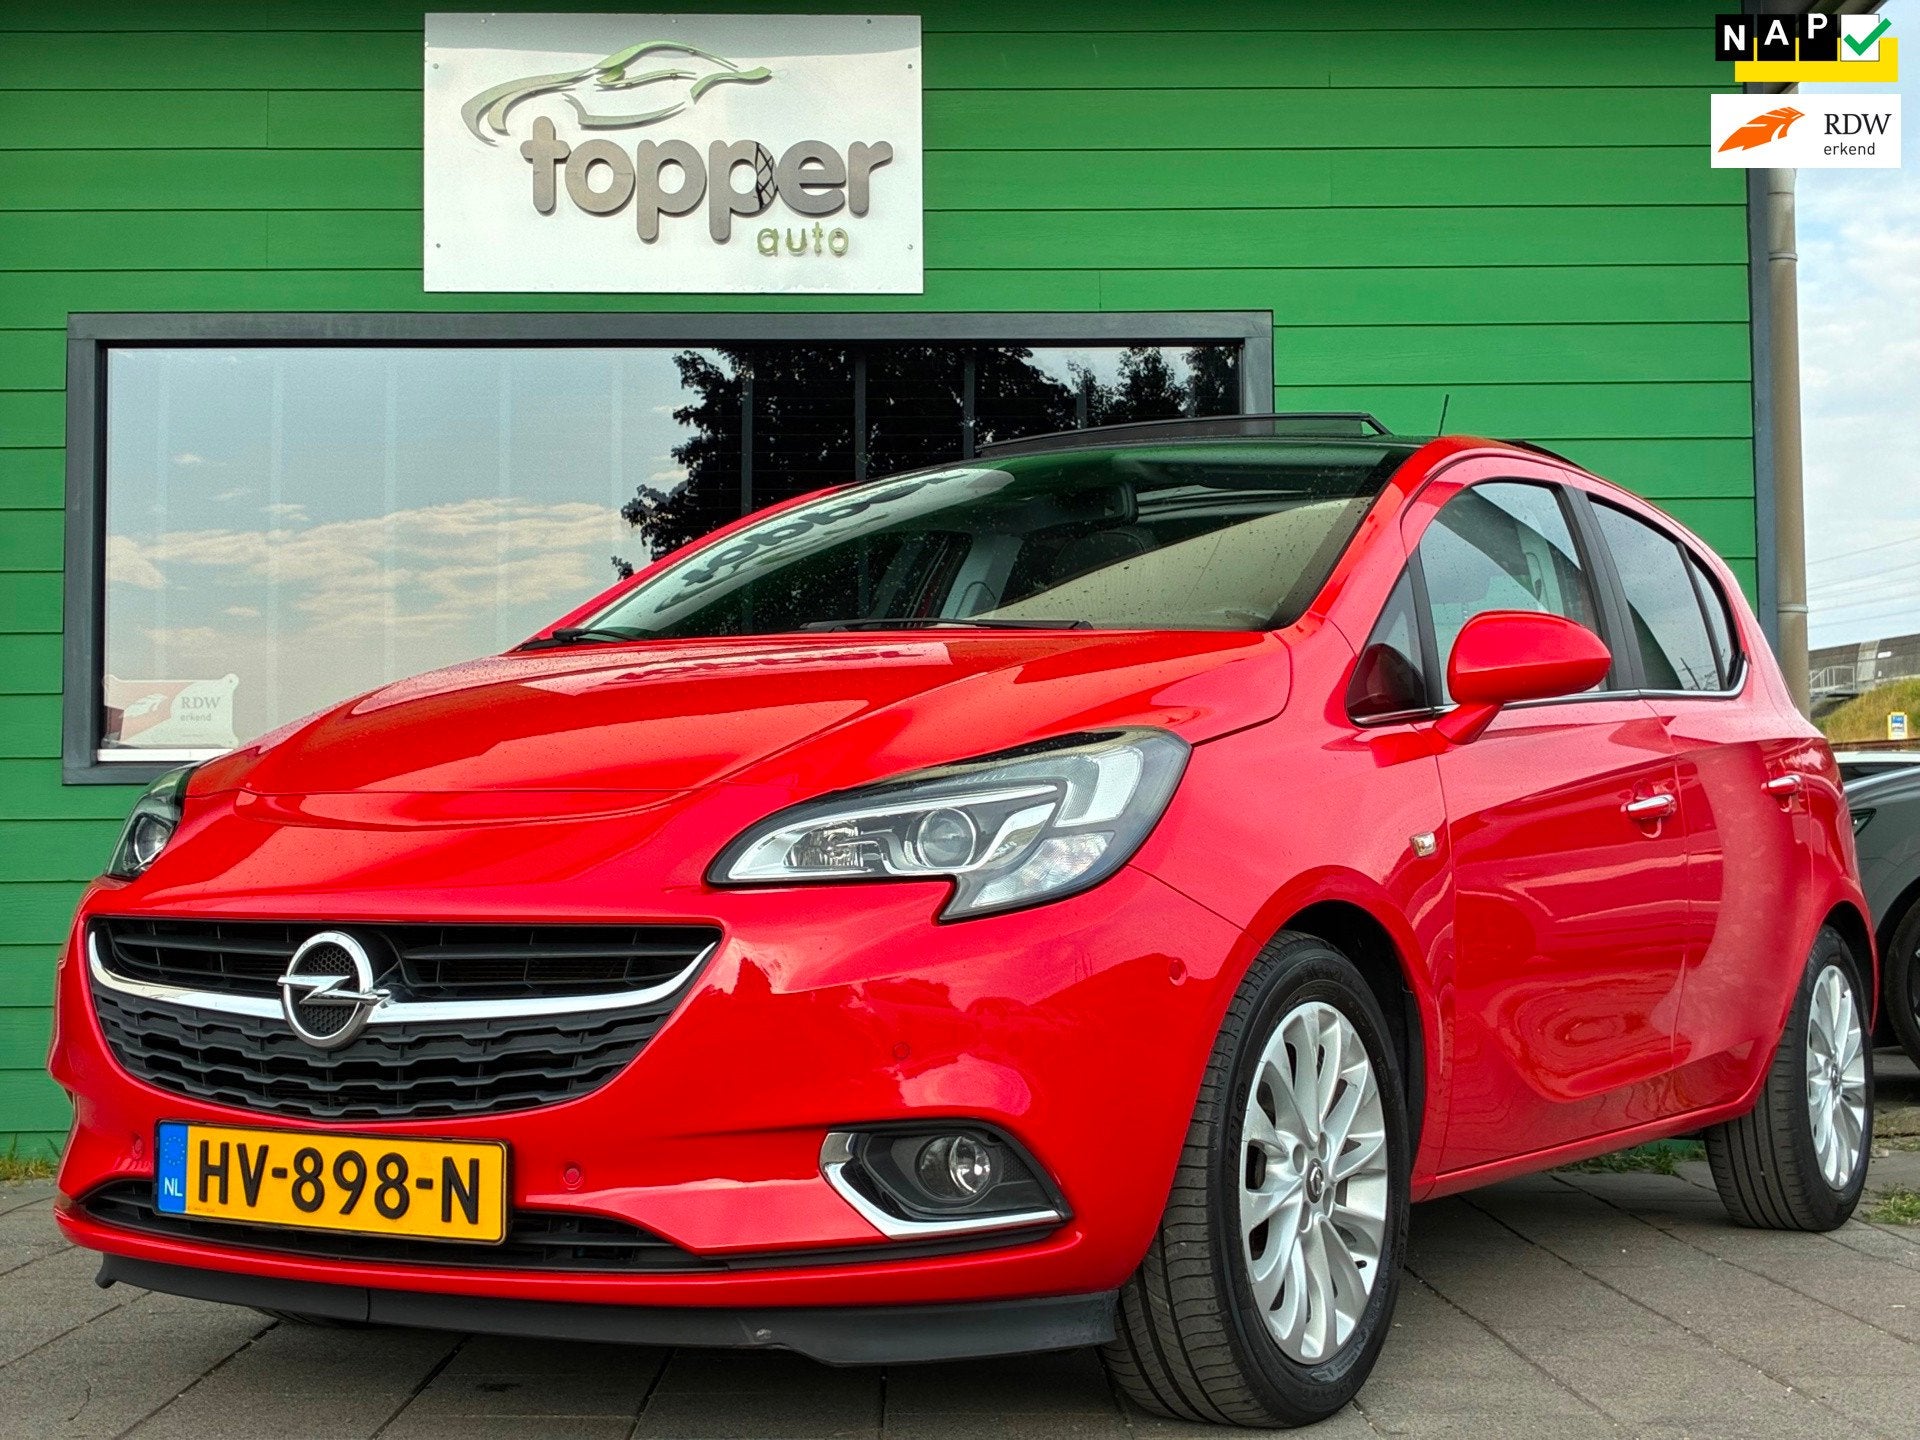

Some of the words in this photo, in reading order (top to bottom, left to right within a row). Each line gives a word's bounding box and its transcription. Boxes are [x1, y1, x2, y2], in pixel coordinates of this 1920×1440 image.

[520, 116, 894, 242] topper
[757, 221, 850, 256] auto
[180, 696, 221, 709] RDW
[180, 712, 212, 722] erkend
[163, 1177, 183, 1198] NL
[198, 1139, 480, 1225] HV-898-N
